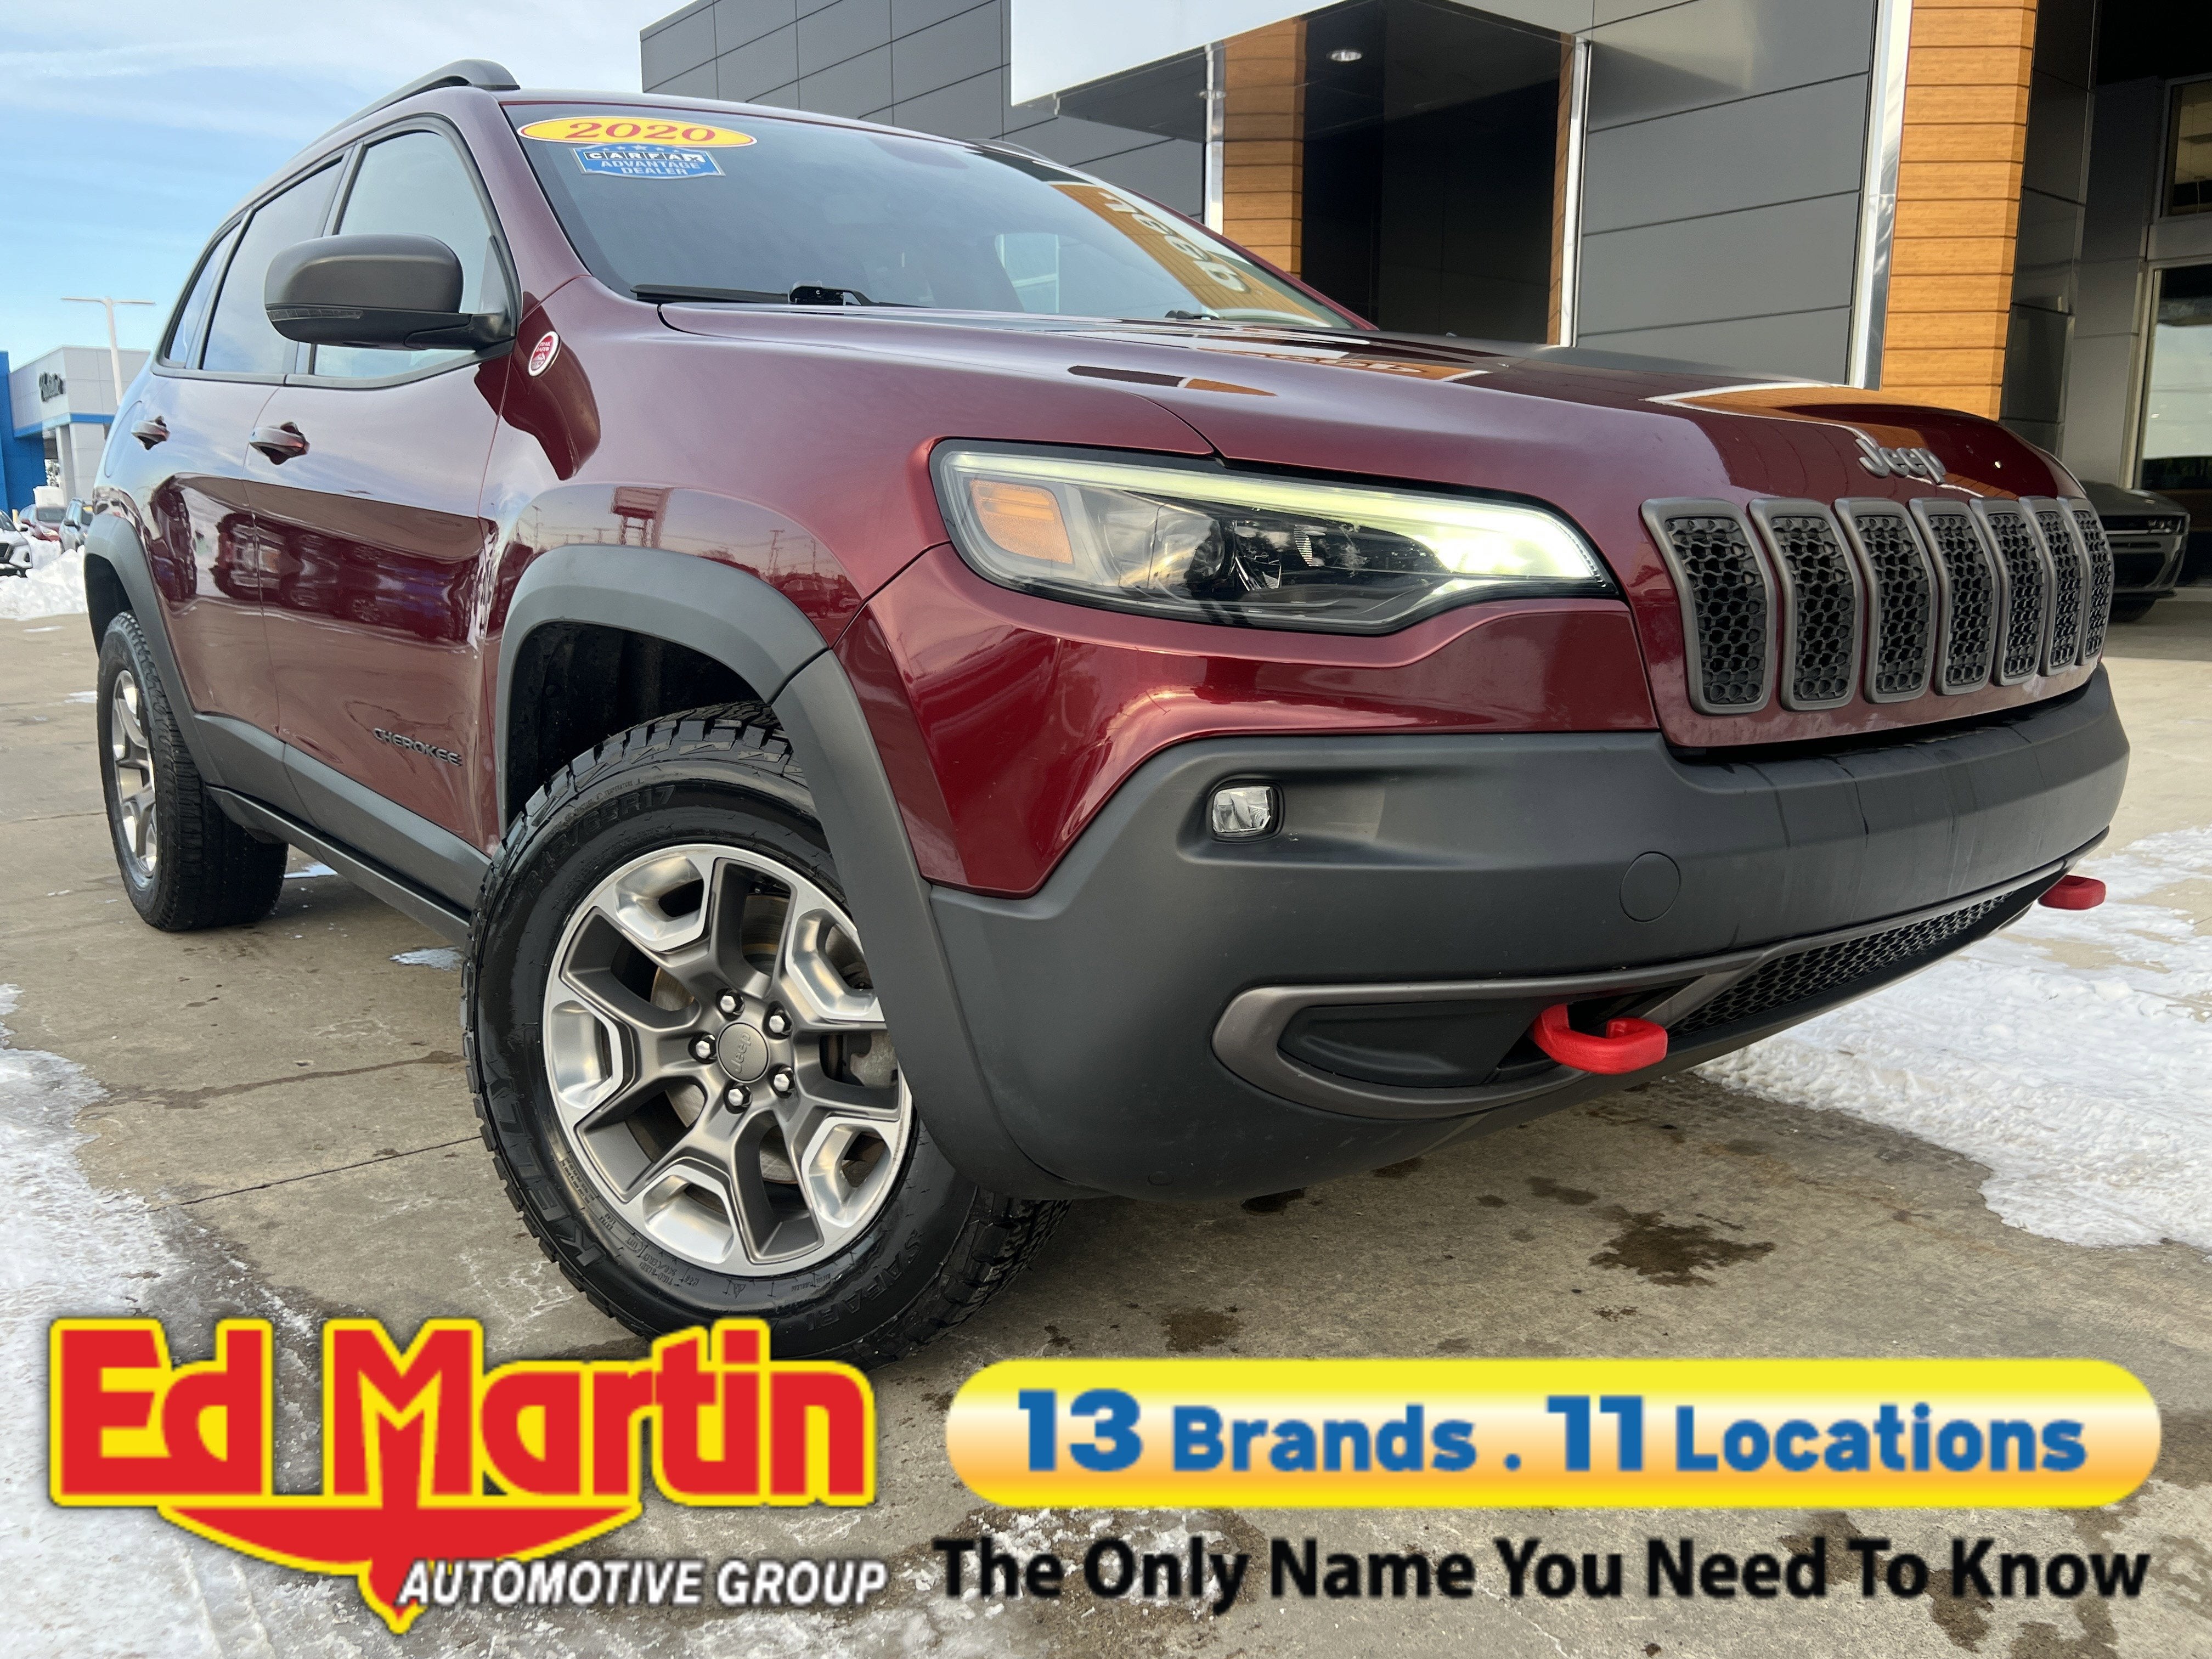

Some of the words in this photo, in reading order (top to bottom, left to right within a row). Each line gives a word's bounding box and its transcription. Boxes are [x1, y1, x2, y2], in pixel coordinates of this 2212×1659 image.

[565, 122, 716, 142] 2020
[586, 152, 706, 163] CARFAX
[601, 160, 701, 170] ADVANTAGE
[620, 167, 689, 176] DEALER
[1855, 438, 1947, 484] Jeep
[374, 727, 463, 767] CHEROKEE
[730, 1032, 752, 1074] Jeep
[485, 1053, 607, 1268] KELLY
[806, 1229, 923, 1332] SAFARI
